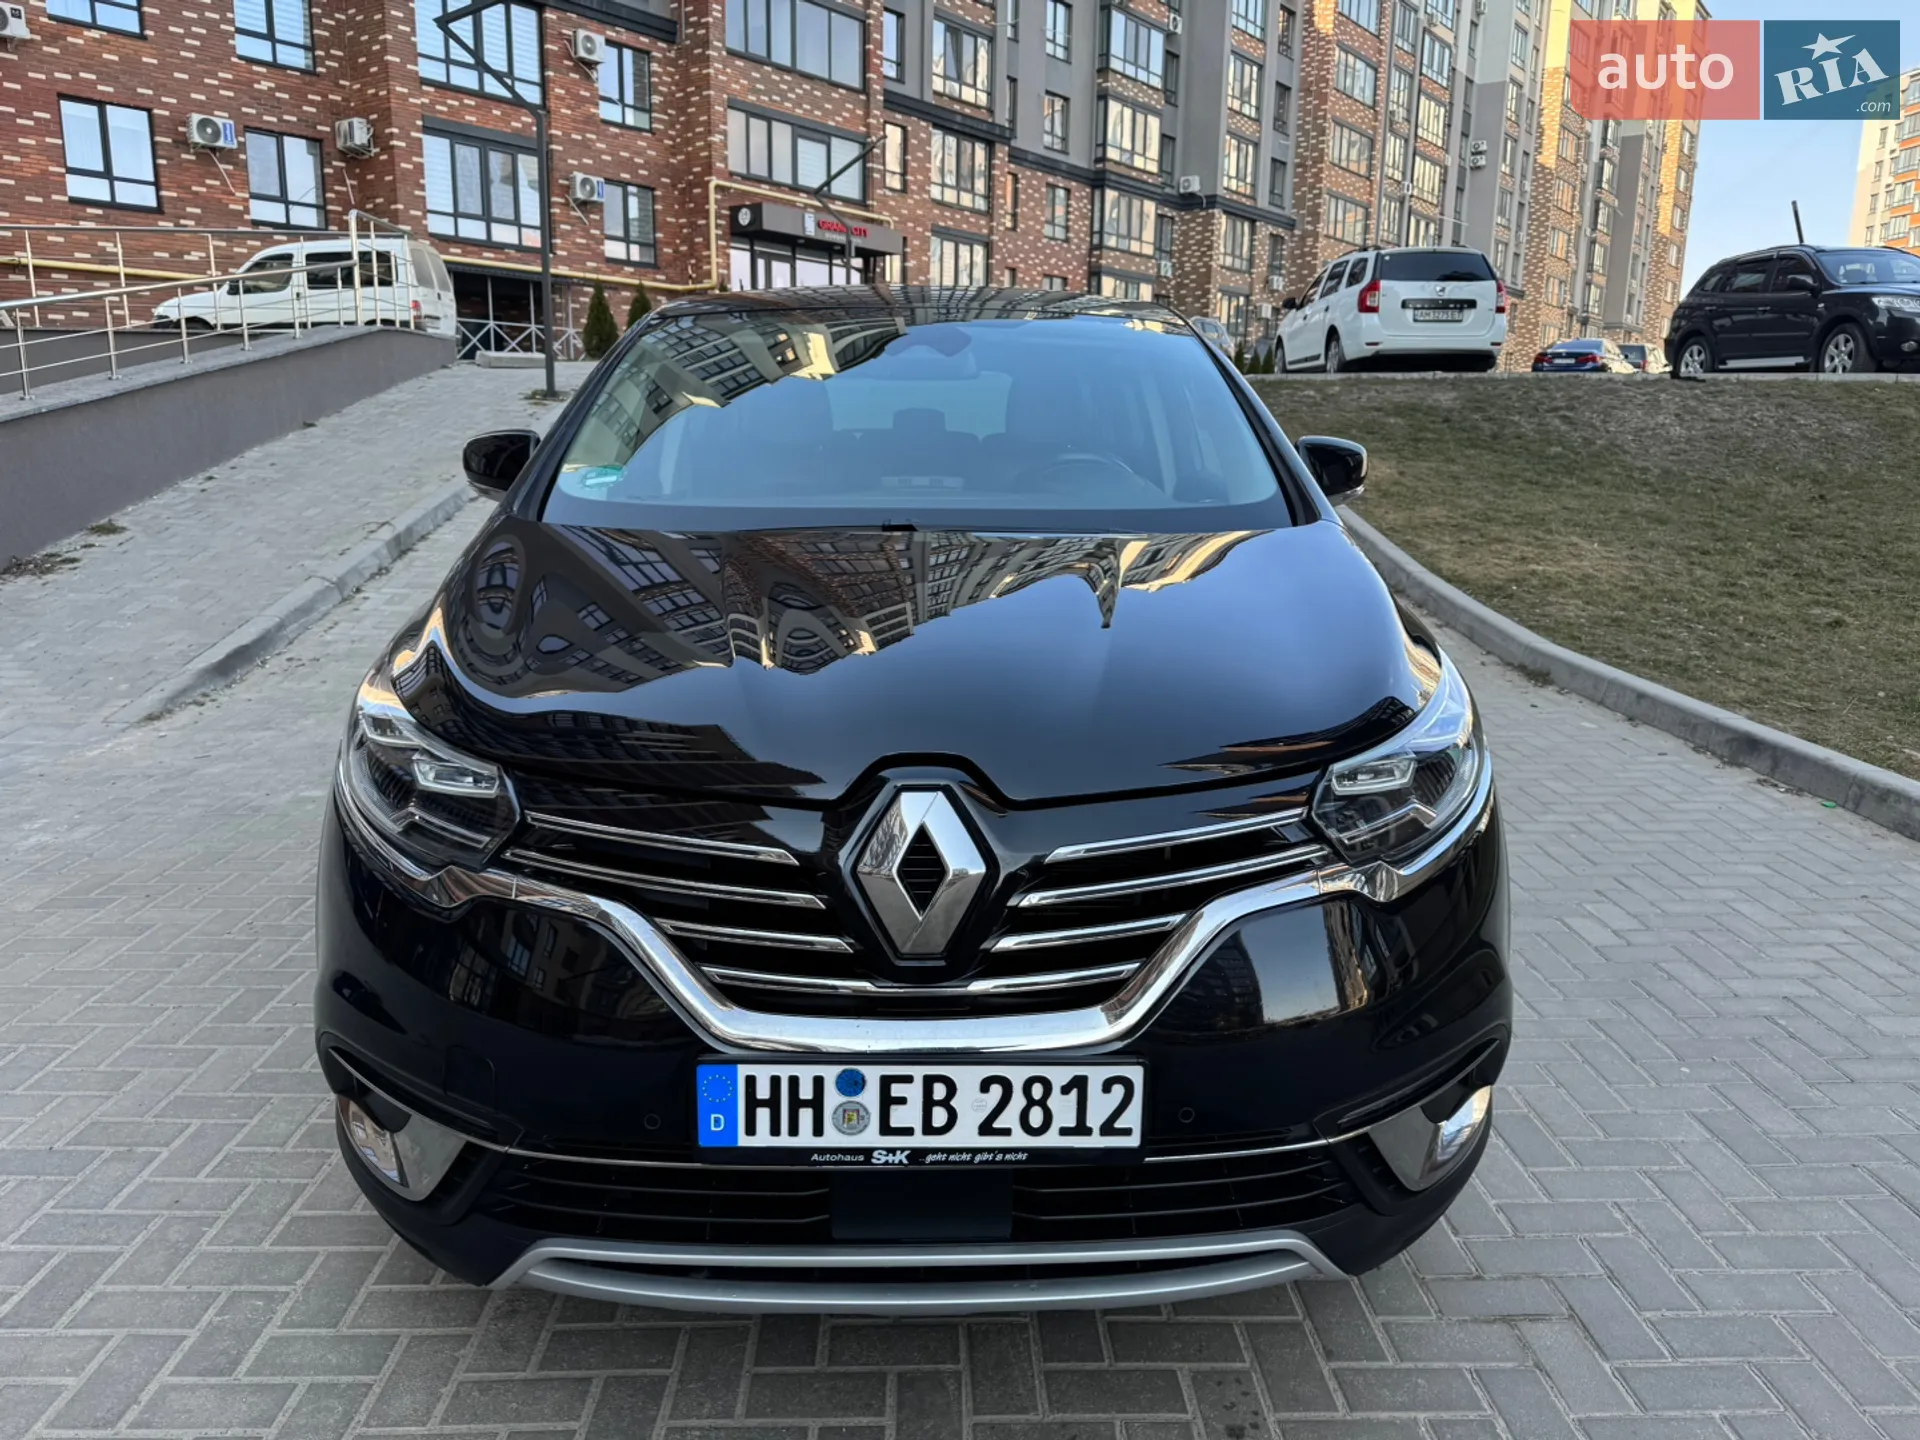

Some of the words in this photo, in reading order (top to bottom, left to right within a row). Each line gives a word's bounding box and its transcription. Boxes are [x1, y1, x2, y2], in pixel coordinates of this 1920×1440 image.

[818, 218, 848, 234] GRAN
[744, 1074, 825, 1138] HH
[878, 1073, 959, 1138] EB
[977, 1074, 1135, 1138] 2812
[710, 1113, 725, 1131] D
[811, 1153, 865, 1162] Autohaus
[871, 1149, 911, 1164] S+K
[948, 1152, 972, 1161] nicht
[1004, 1151, 1029, 1161] nicht
